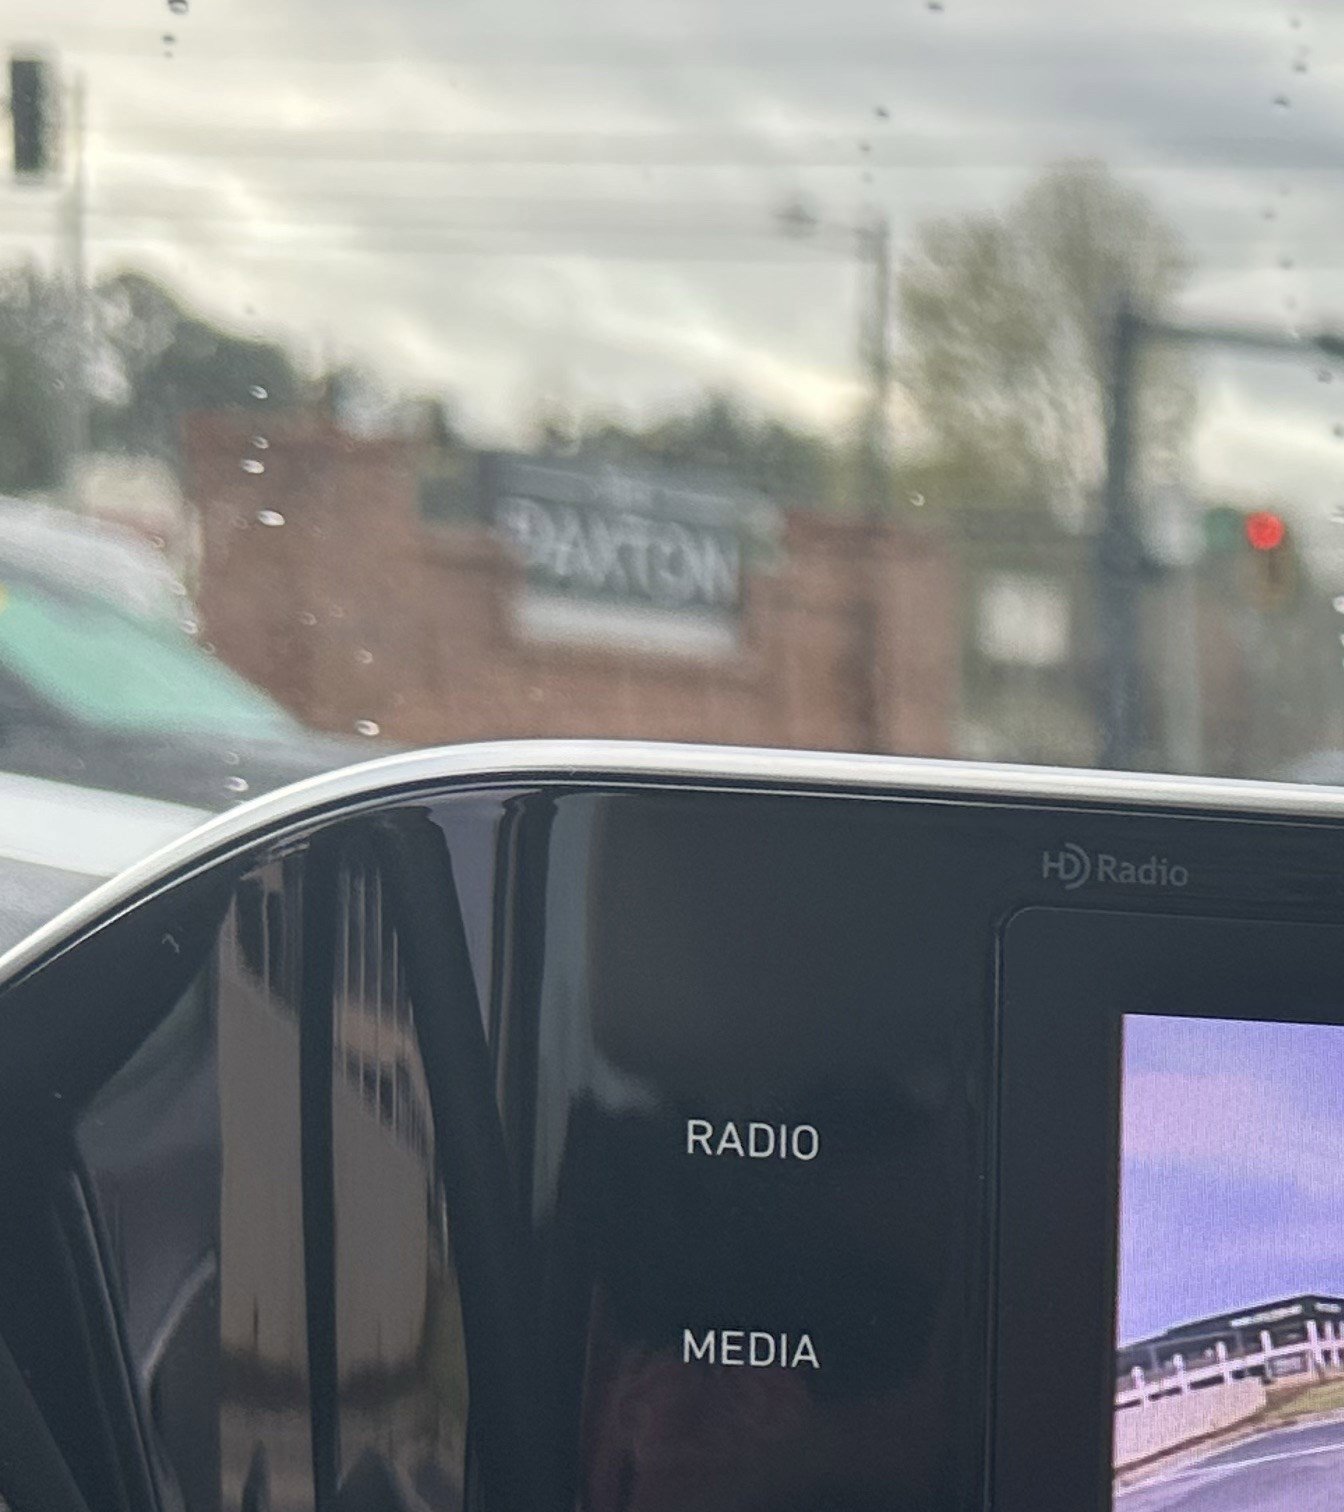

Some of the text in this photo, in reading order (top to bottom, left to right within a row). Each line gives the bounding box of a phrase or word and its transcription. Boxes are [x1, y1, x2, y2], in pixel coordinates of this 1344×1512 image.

[1042, 846, 1190, 887] HD Radio
[686, 1118, 820, 1161] RADIO
[682, 1327, 821, 1370] MEDIA
